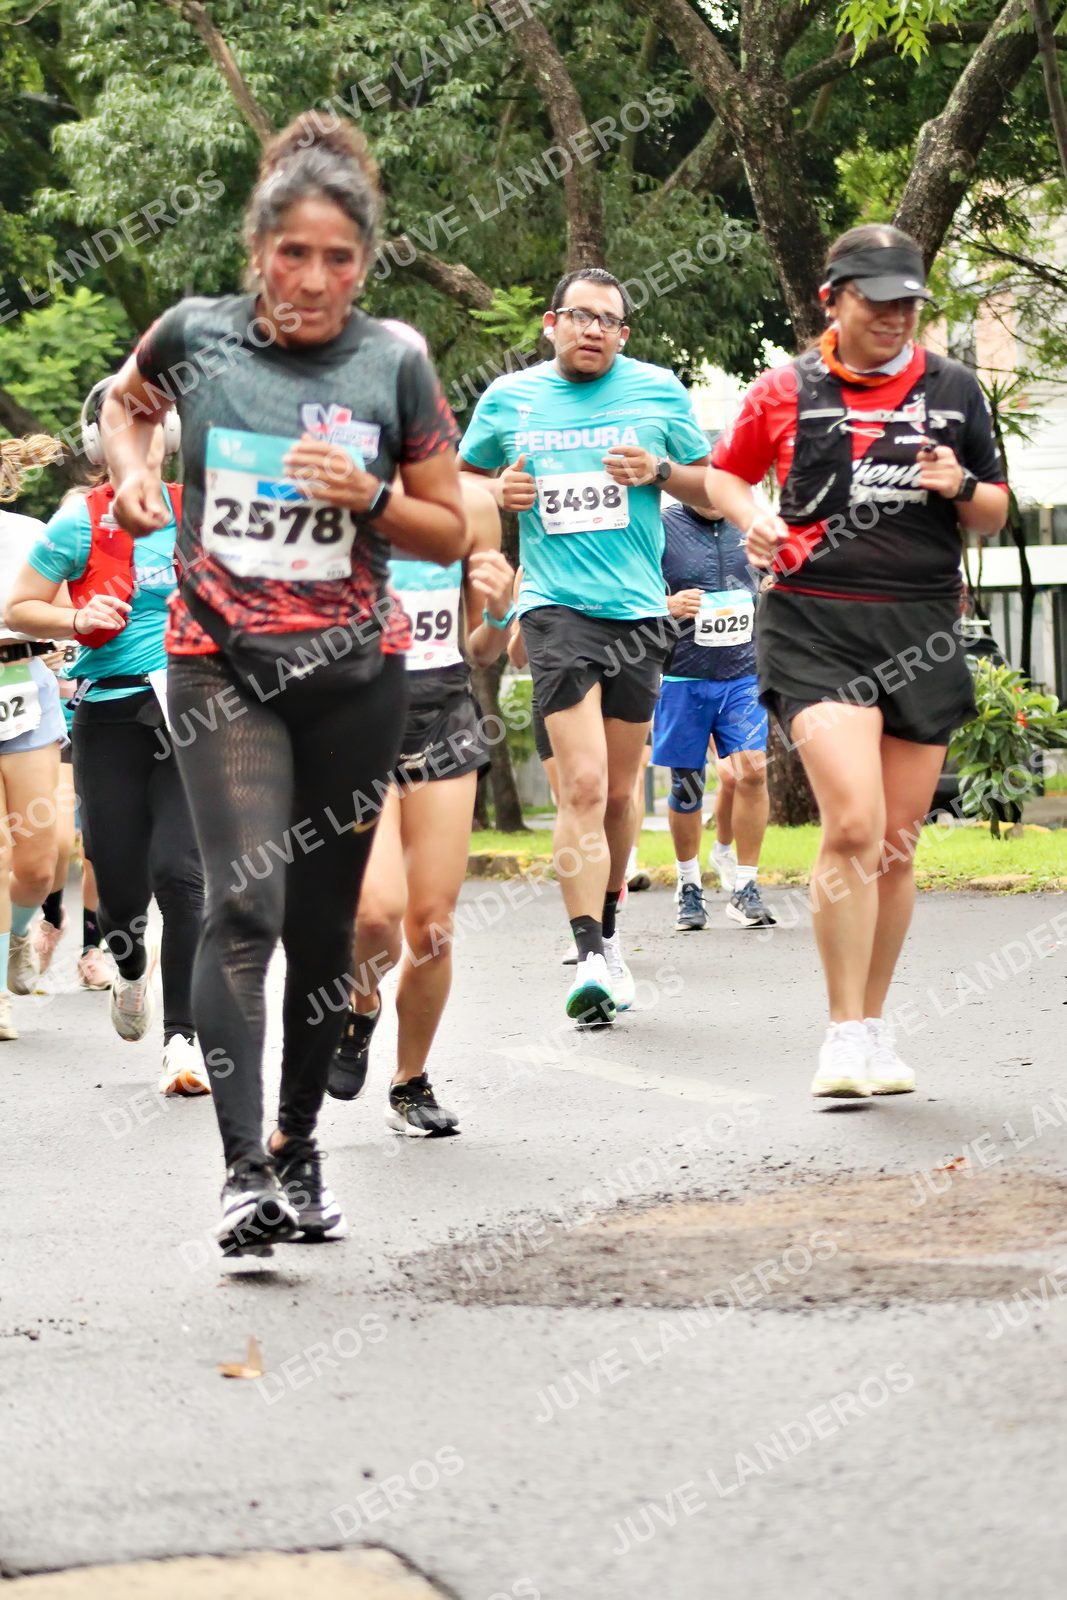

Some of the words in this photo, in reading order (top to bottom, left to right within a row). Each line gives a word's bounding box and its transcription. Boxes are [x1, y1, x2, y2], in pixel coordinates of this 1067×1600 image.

[514, 426, 639, 452] PERDURA
[543, 485, 622, 514] 3498
[213, 497, 344, 545] 2578
[409, 609, 453, 641] 59
[699, 615, 749, 634] 5029
